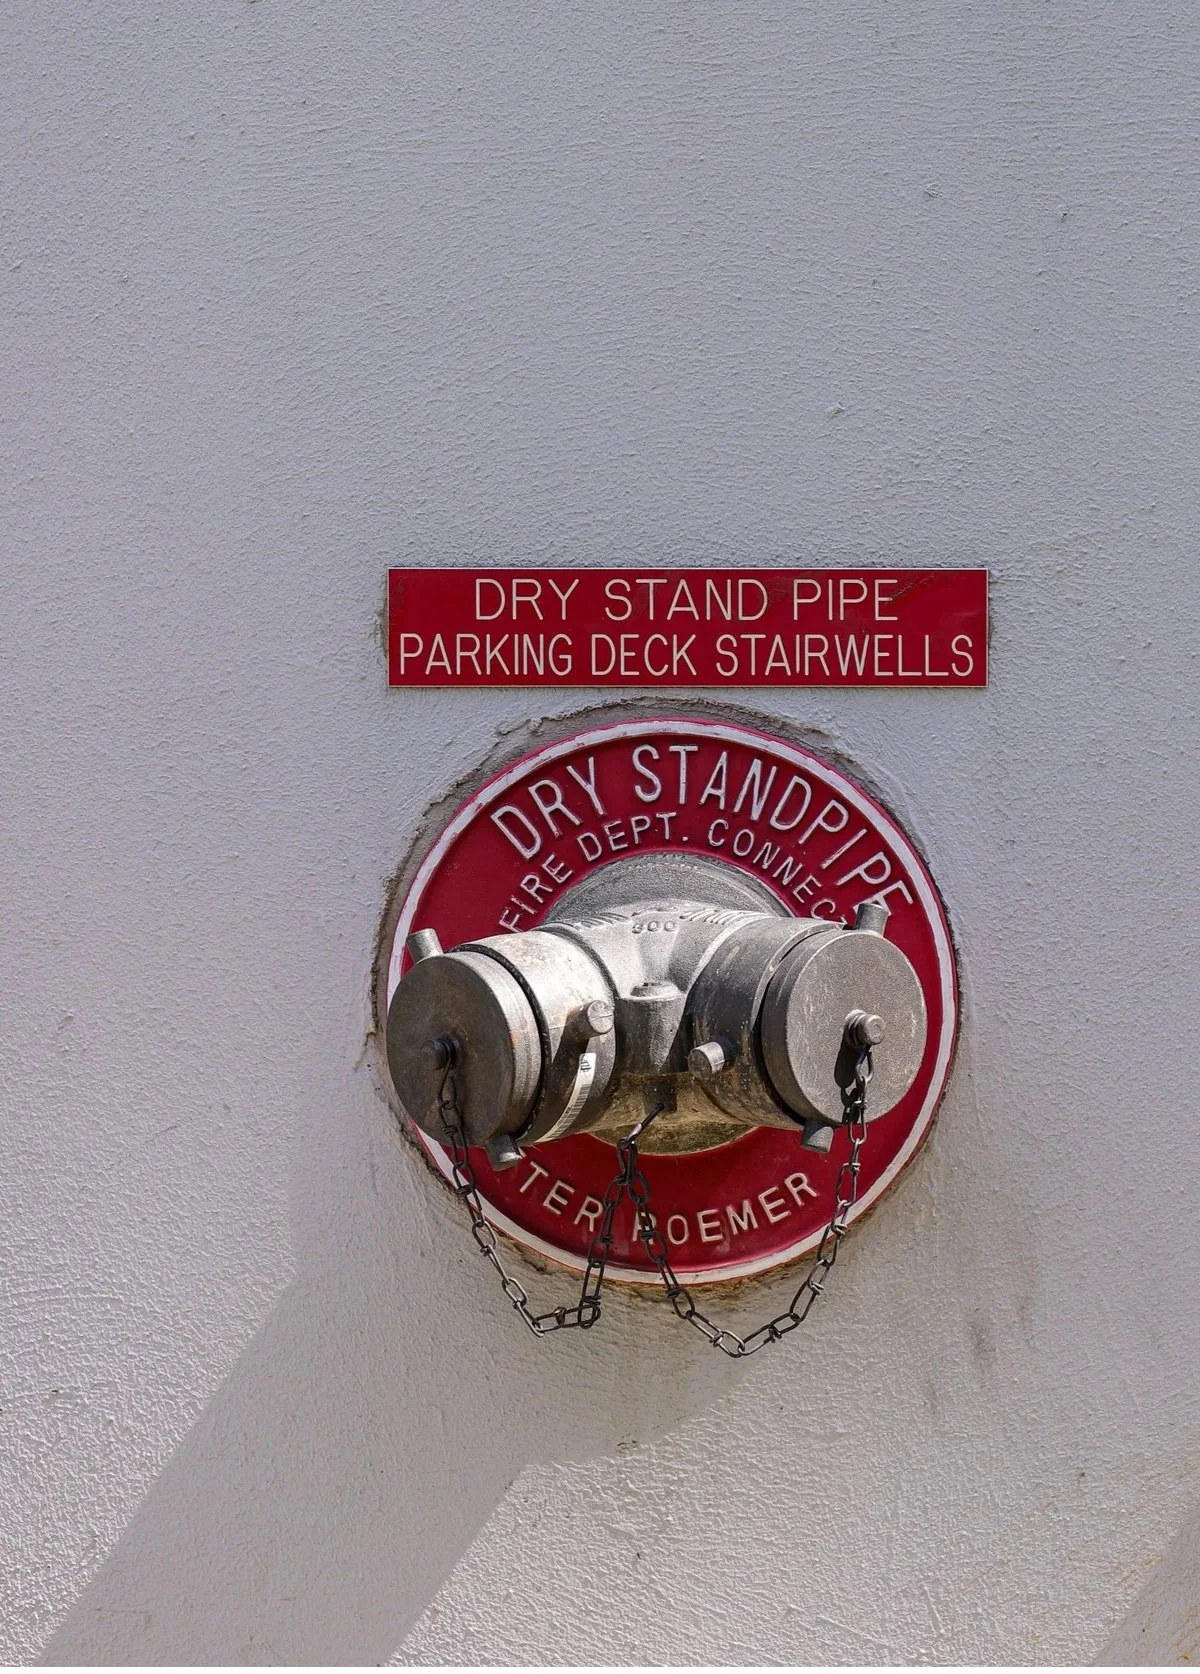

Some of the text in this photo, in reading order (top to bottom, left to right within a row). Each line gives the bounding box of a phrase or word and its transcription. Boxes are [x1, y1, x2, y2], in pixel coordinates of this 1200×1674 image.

[475, 578, 898, 621] DRY STAND PIPE
[400, 633, 974, 677] PARKING DECK STAIRWELLS
[490, 744, 914, 917] DRY STANDPIPE
[499, 811, 848, 933] FIRE DEPT. CONNEC
[632, 1172, 818, 1246] ROEMER
